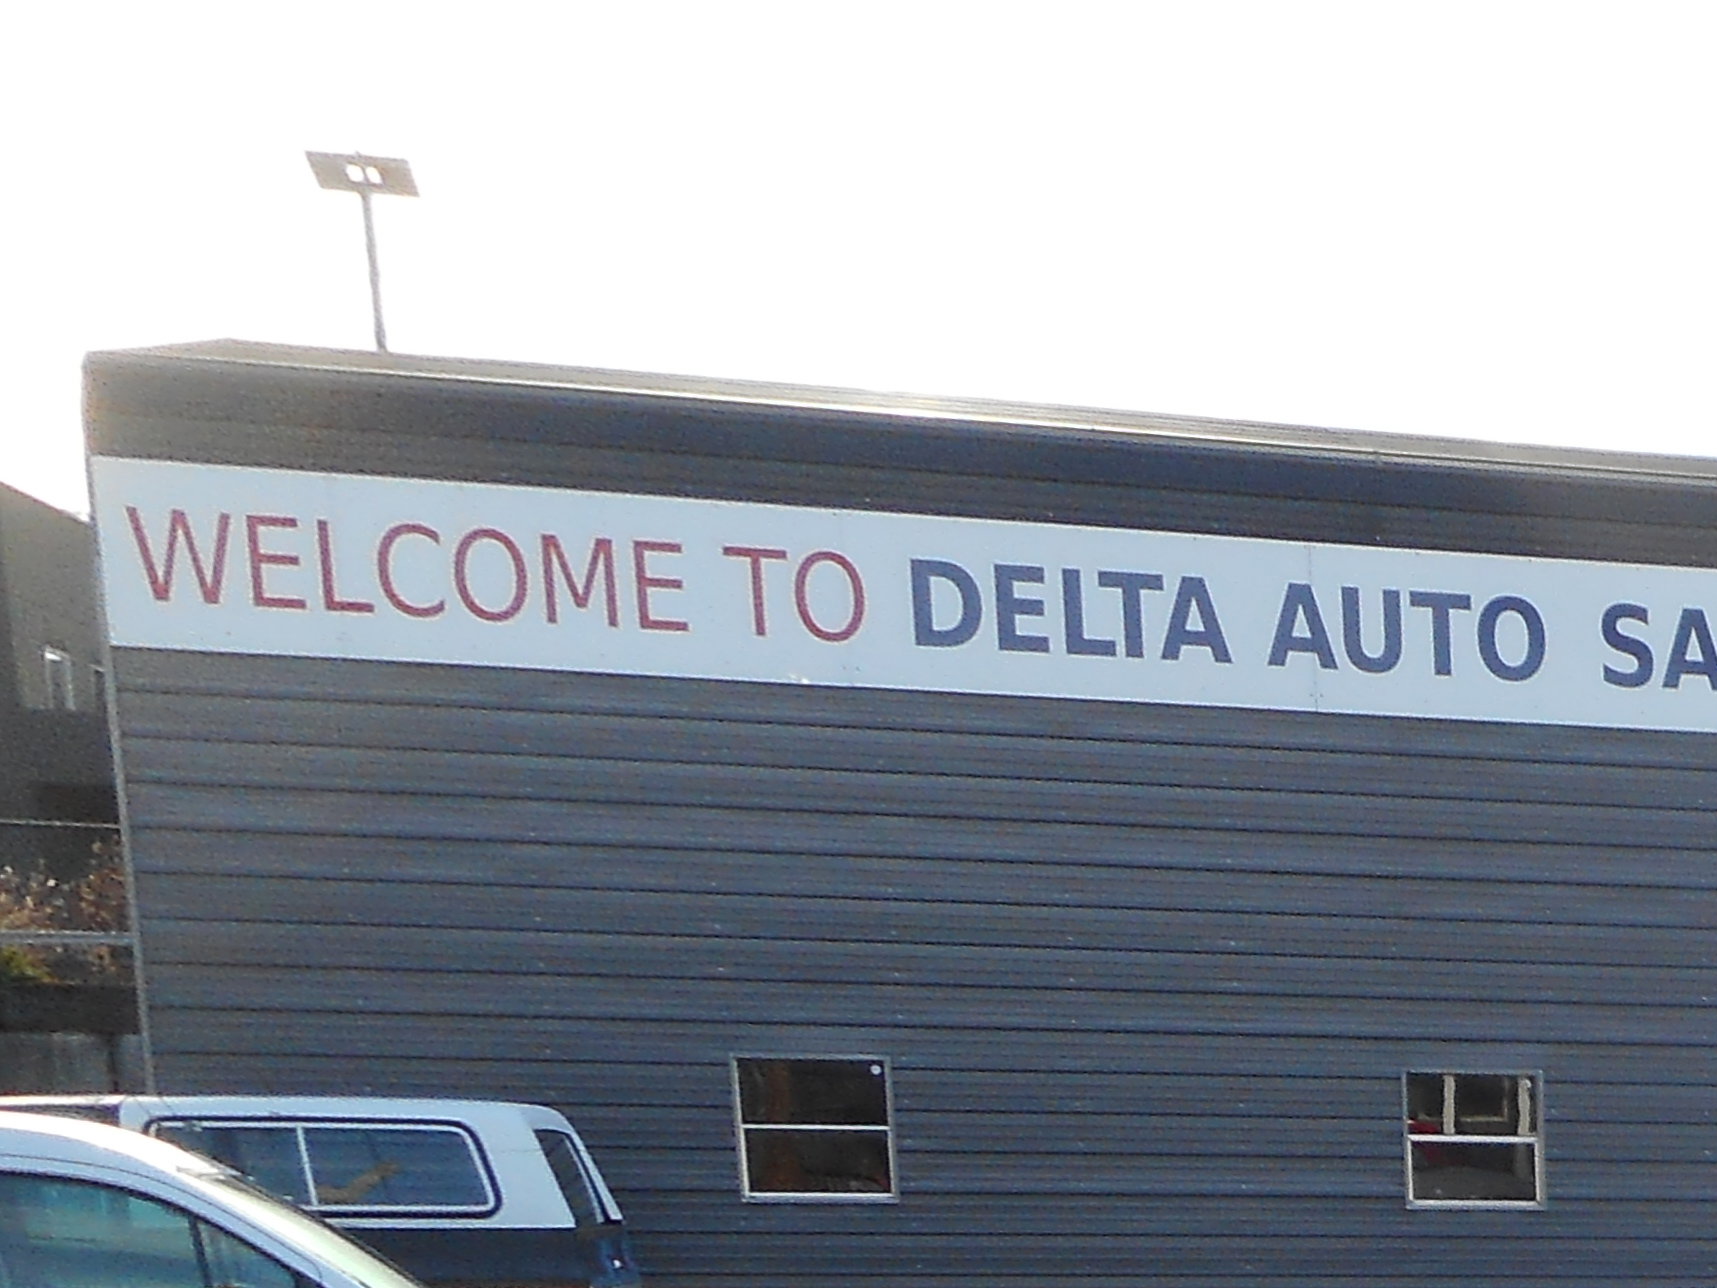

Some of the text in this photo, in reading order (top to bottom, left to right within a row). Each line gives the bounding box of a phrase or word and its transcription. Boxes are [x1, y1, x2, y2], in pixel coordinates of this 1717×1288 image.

[126, 505, 690, 632] WELCOME
[722, 546, 865, 643] TO
[909, 558, 1232, 664] DELTA
[1268, 582, 1547, 683] AUTO
